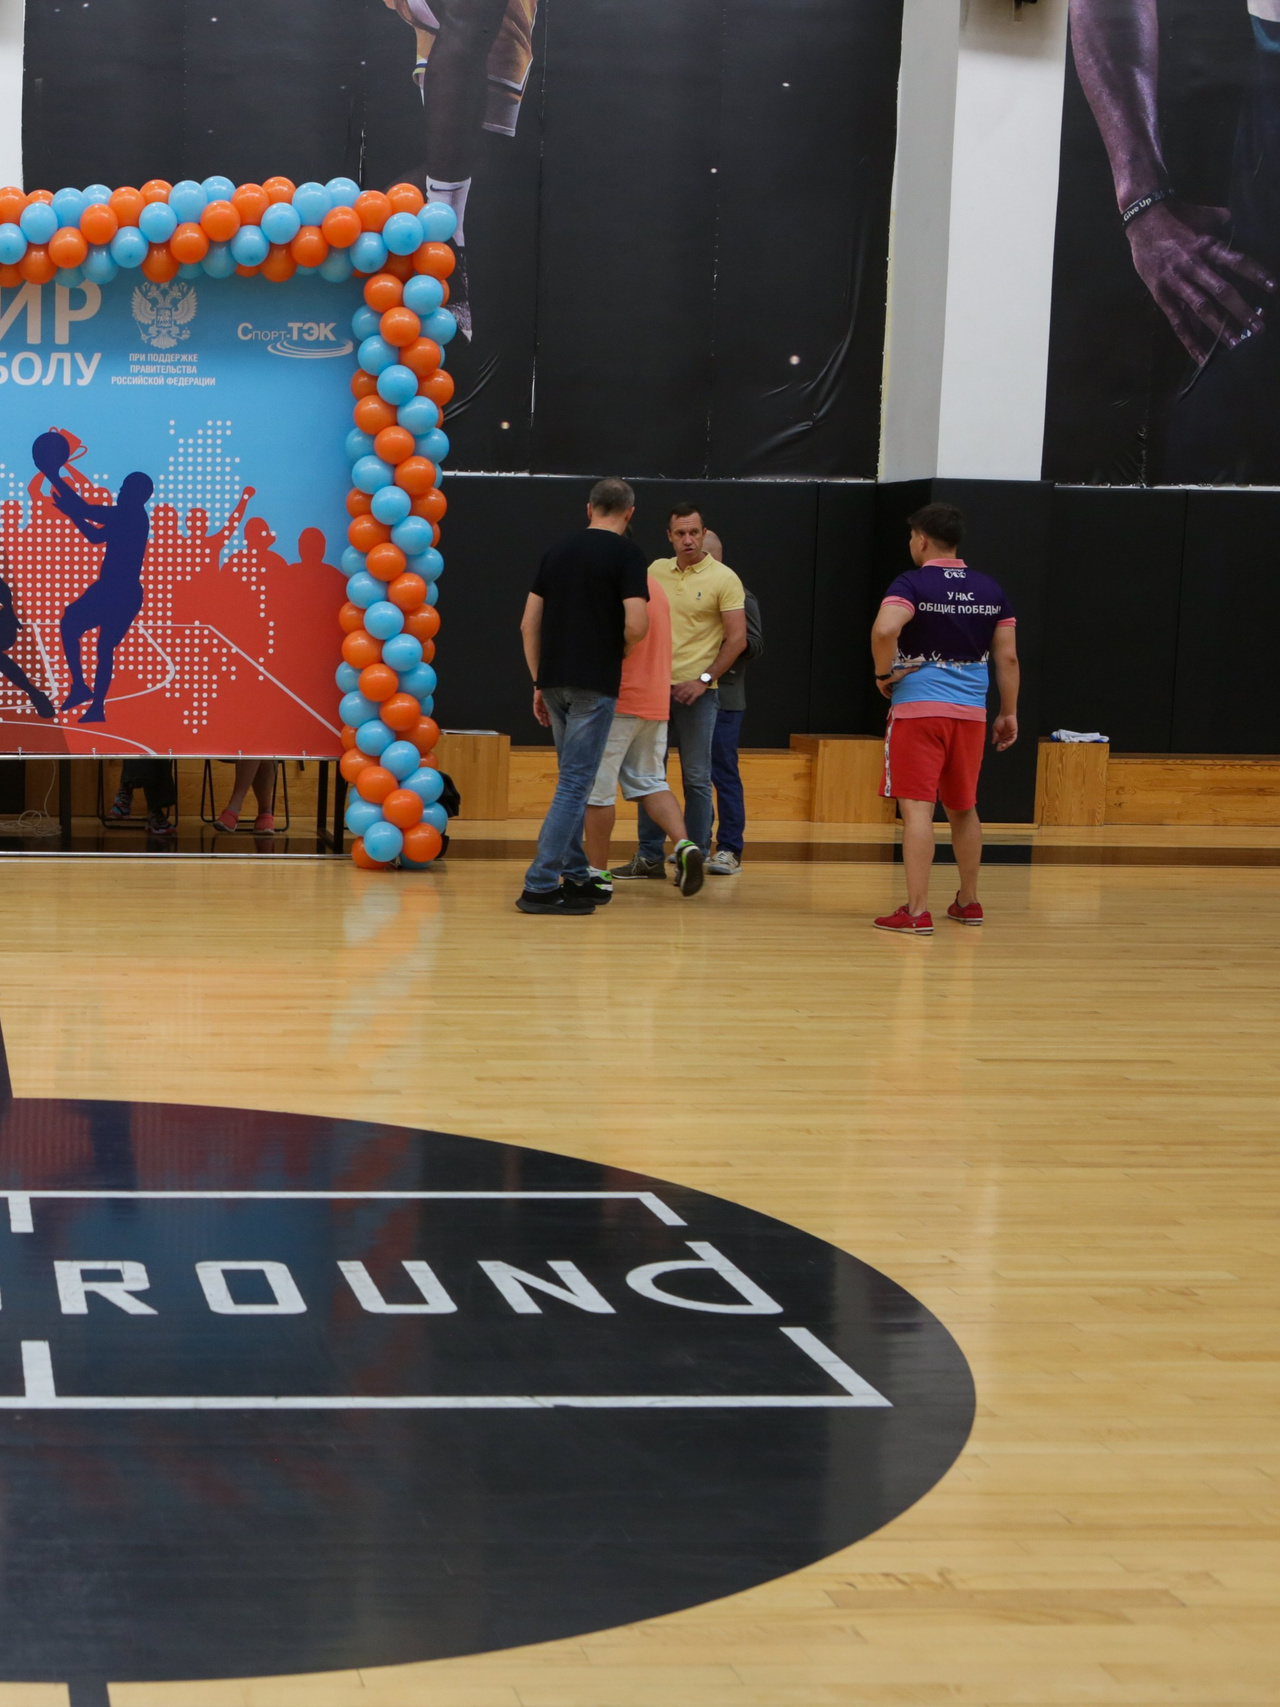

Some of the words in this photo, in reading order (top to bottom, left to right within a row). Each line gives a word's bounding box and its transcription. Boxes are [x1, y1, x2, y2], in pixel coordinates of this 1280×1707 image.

[1123, 206, 1139, 221] Give
[1139, 197, 1152, 208] Up
[129, 353, 146, 362] ПРИ
[147, 353, 198, 363] ПОДДЕРЖКЕ
[130, 365, 197, 374] ПРАВИТЕЛЬСТВА
[111, 375, 164, 385] РОССИЙСКОЙ
[166, 376, 216, 387] ФЕДЕРАЦИИ
[946, 591, 954, 600] У
[955, 592, 975, 601] НАС
[918, 602, 956, 614] ОБЩИЕ
